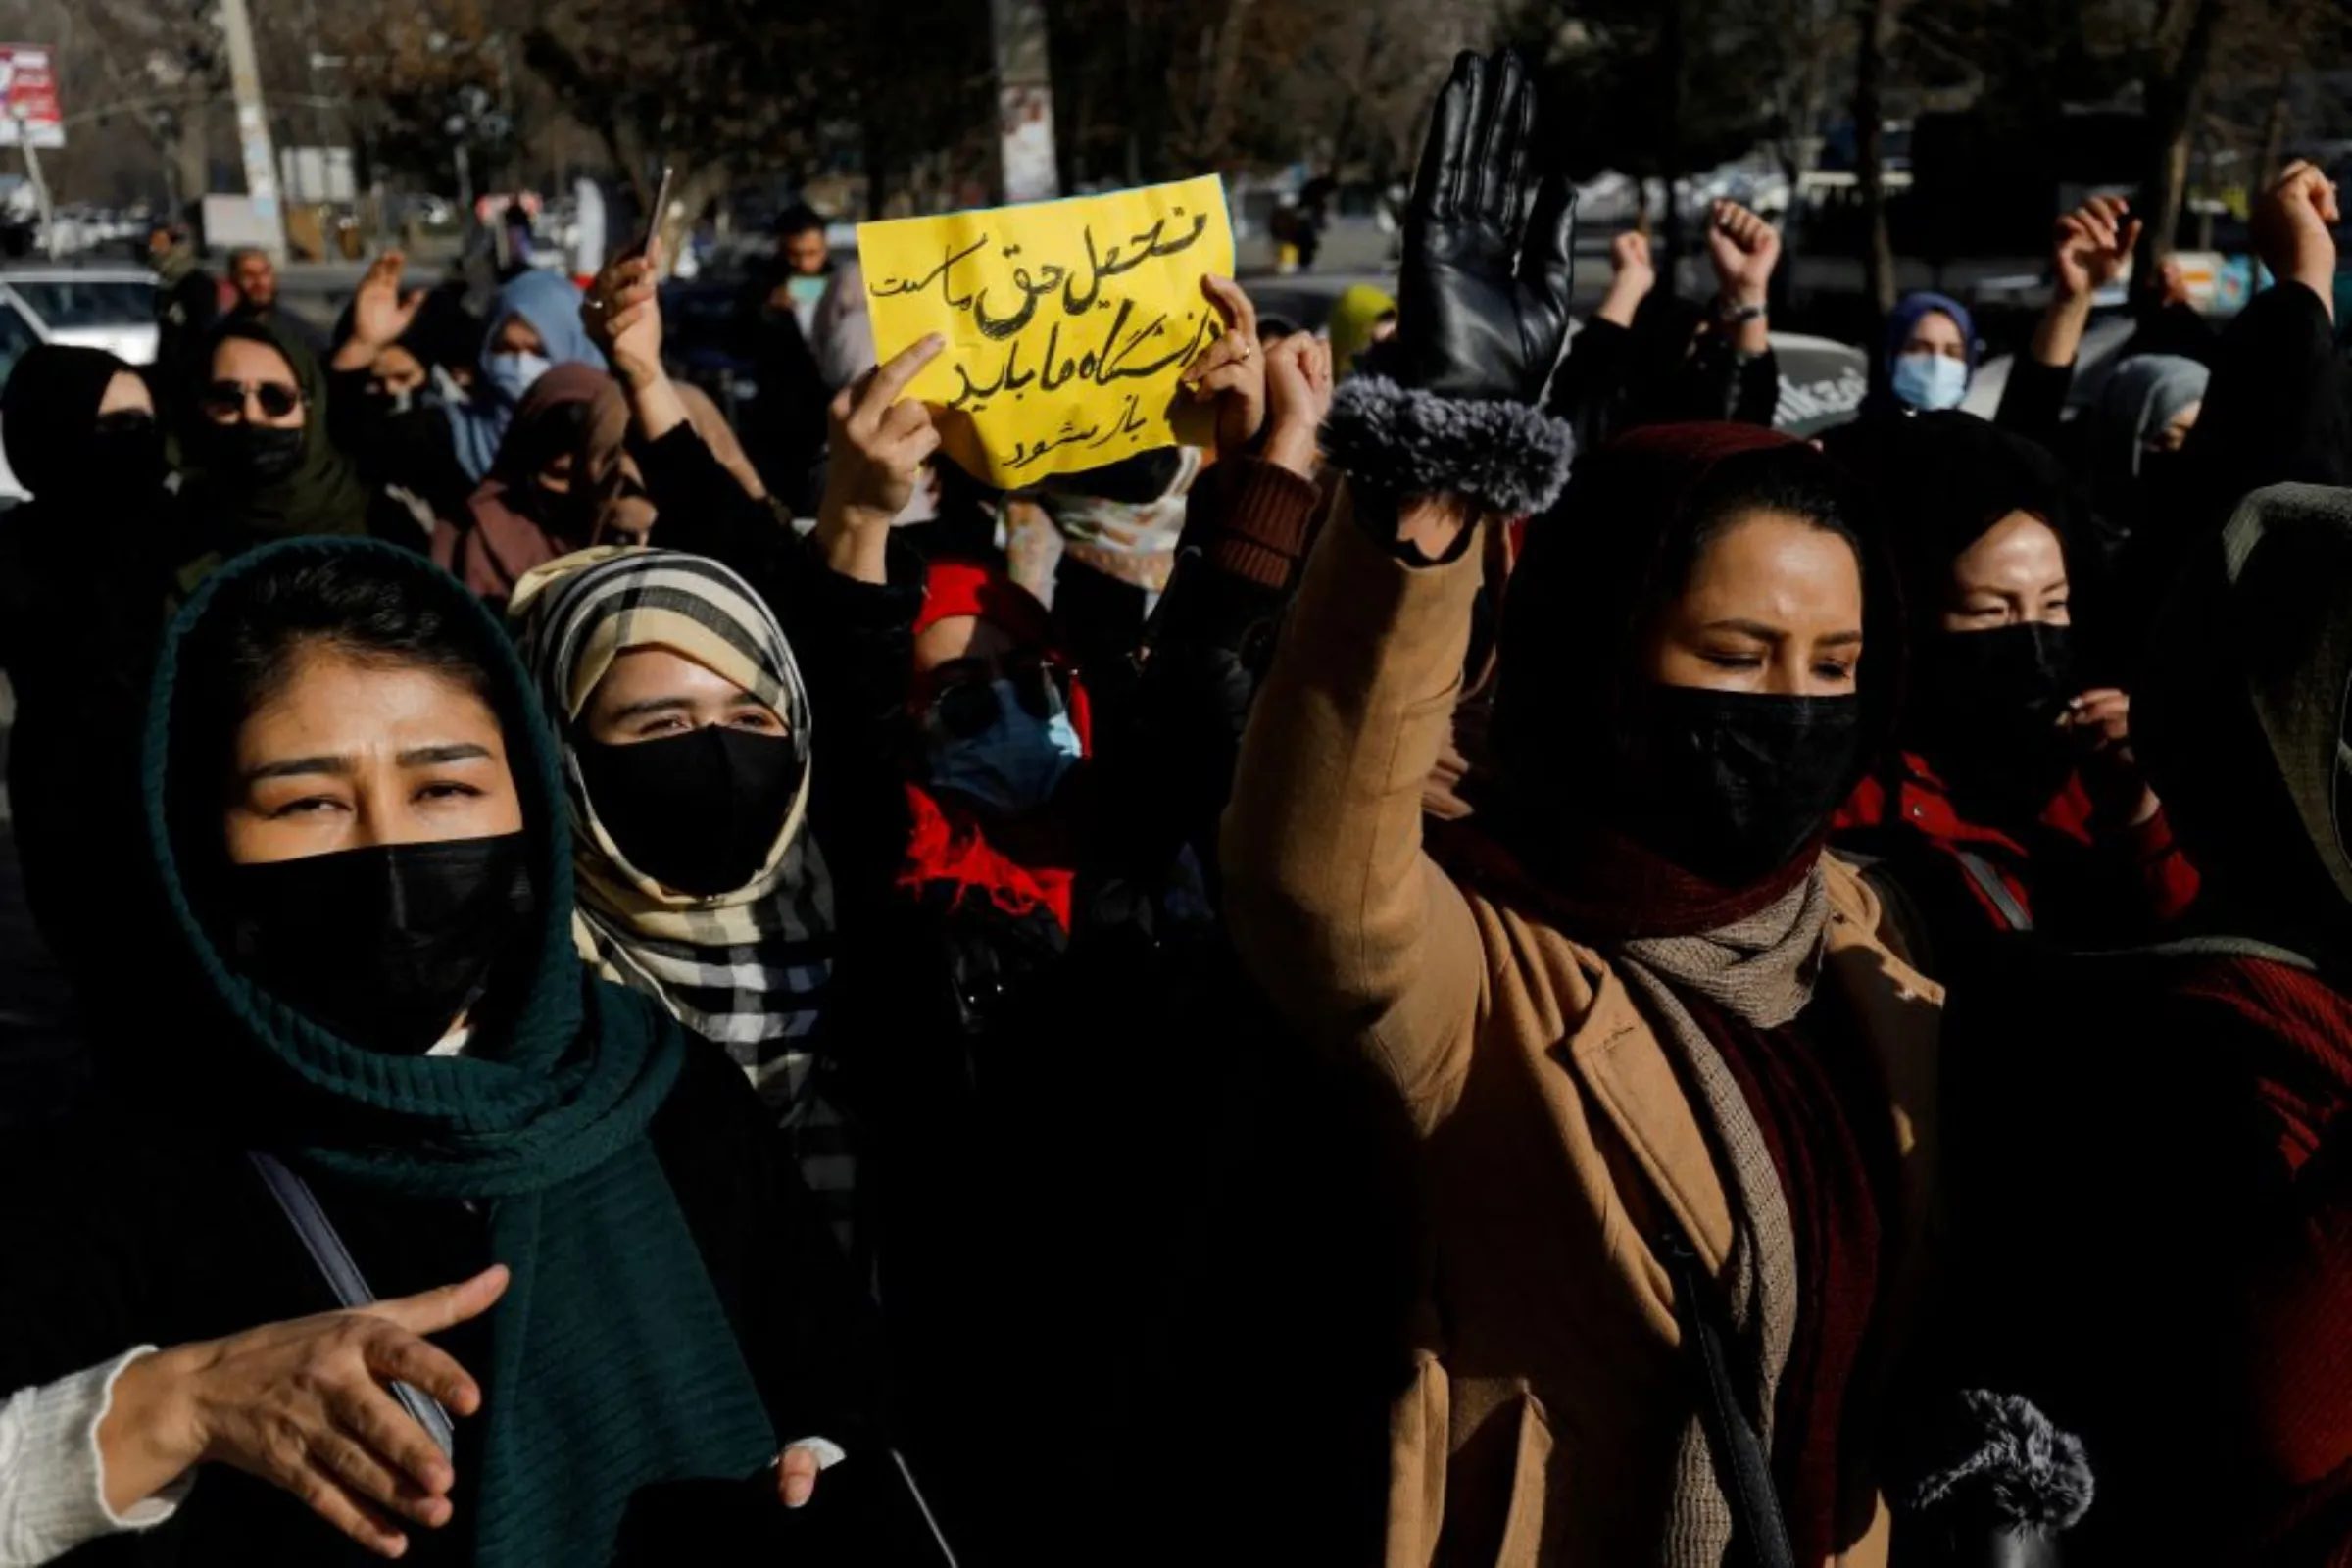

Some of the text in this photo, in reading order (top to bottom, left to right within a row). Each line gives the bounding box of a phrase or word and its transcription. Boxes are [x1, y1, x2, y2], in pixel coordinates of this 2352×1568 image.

[870, 205, 1208, 341] تحصیل حق ماست
[946, 339, 1036, 413] باید
[1088, 394, 1148, 450] باز
